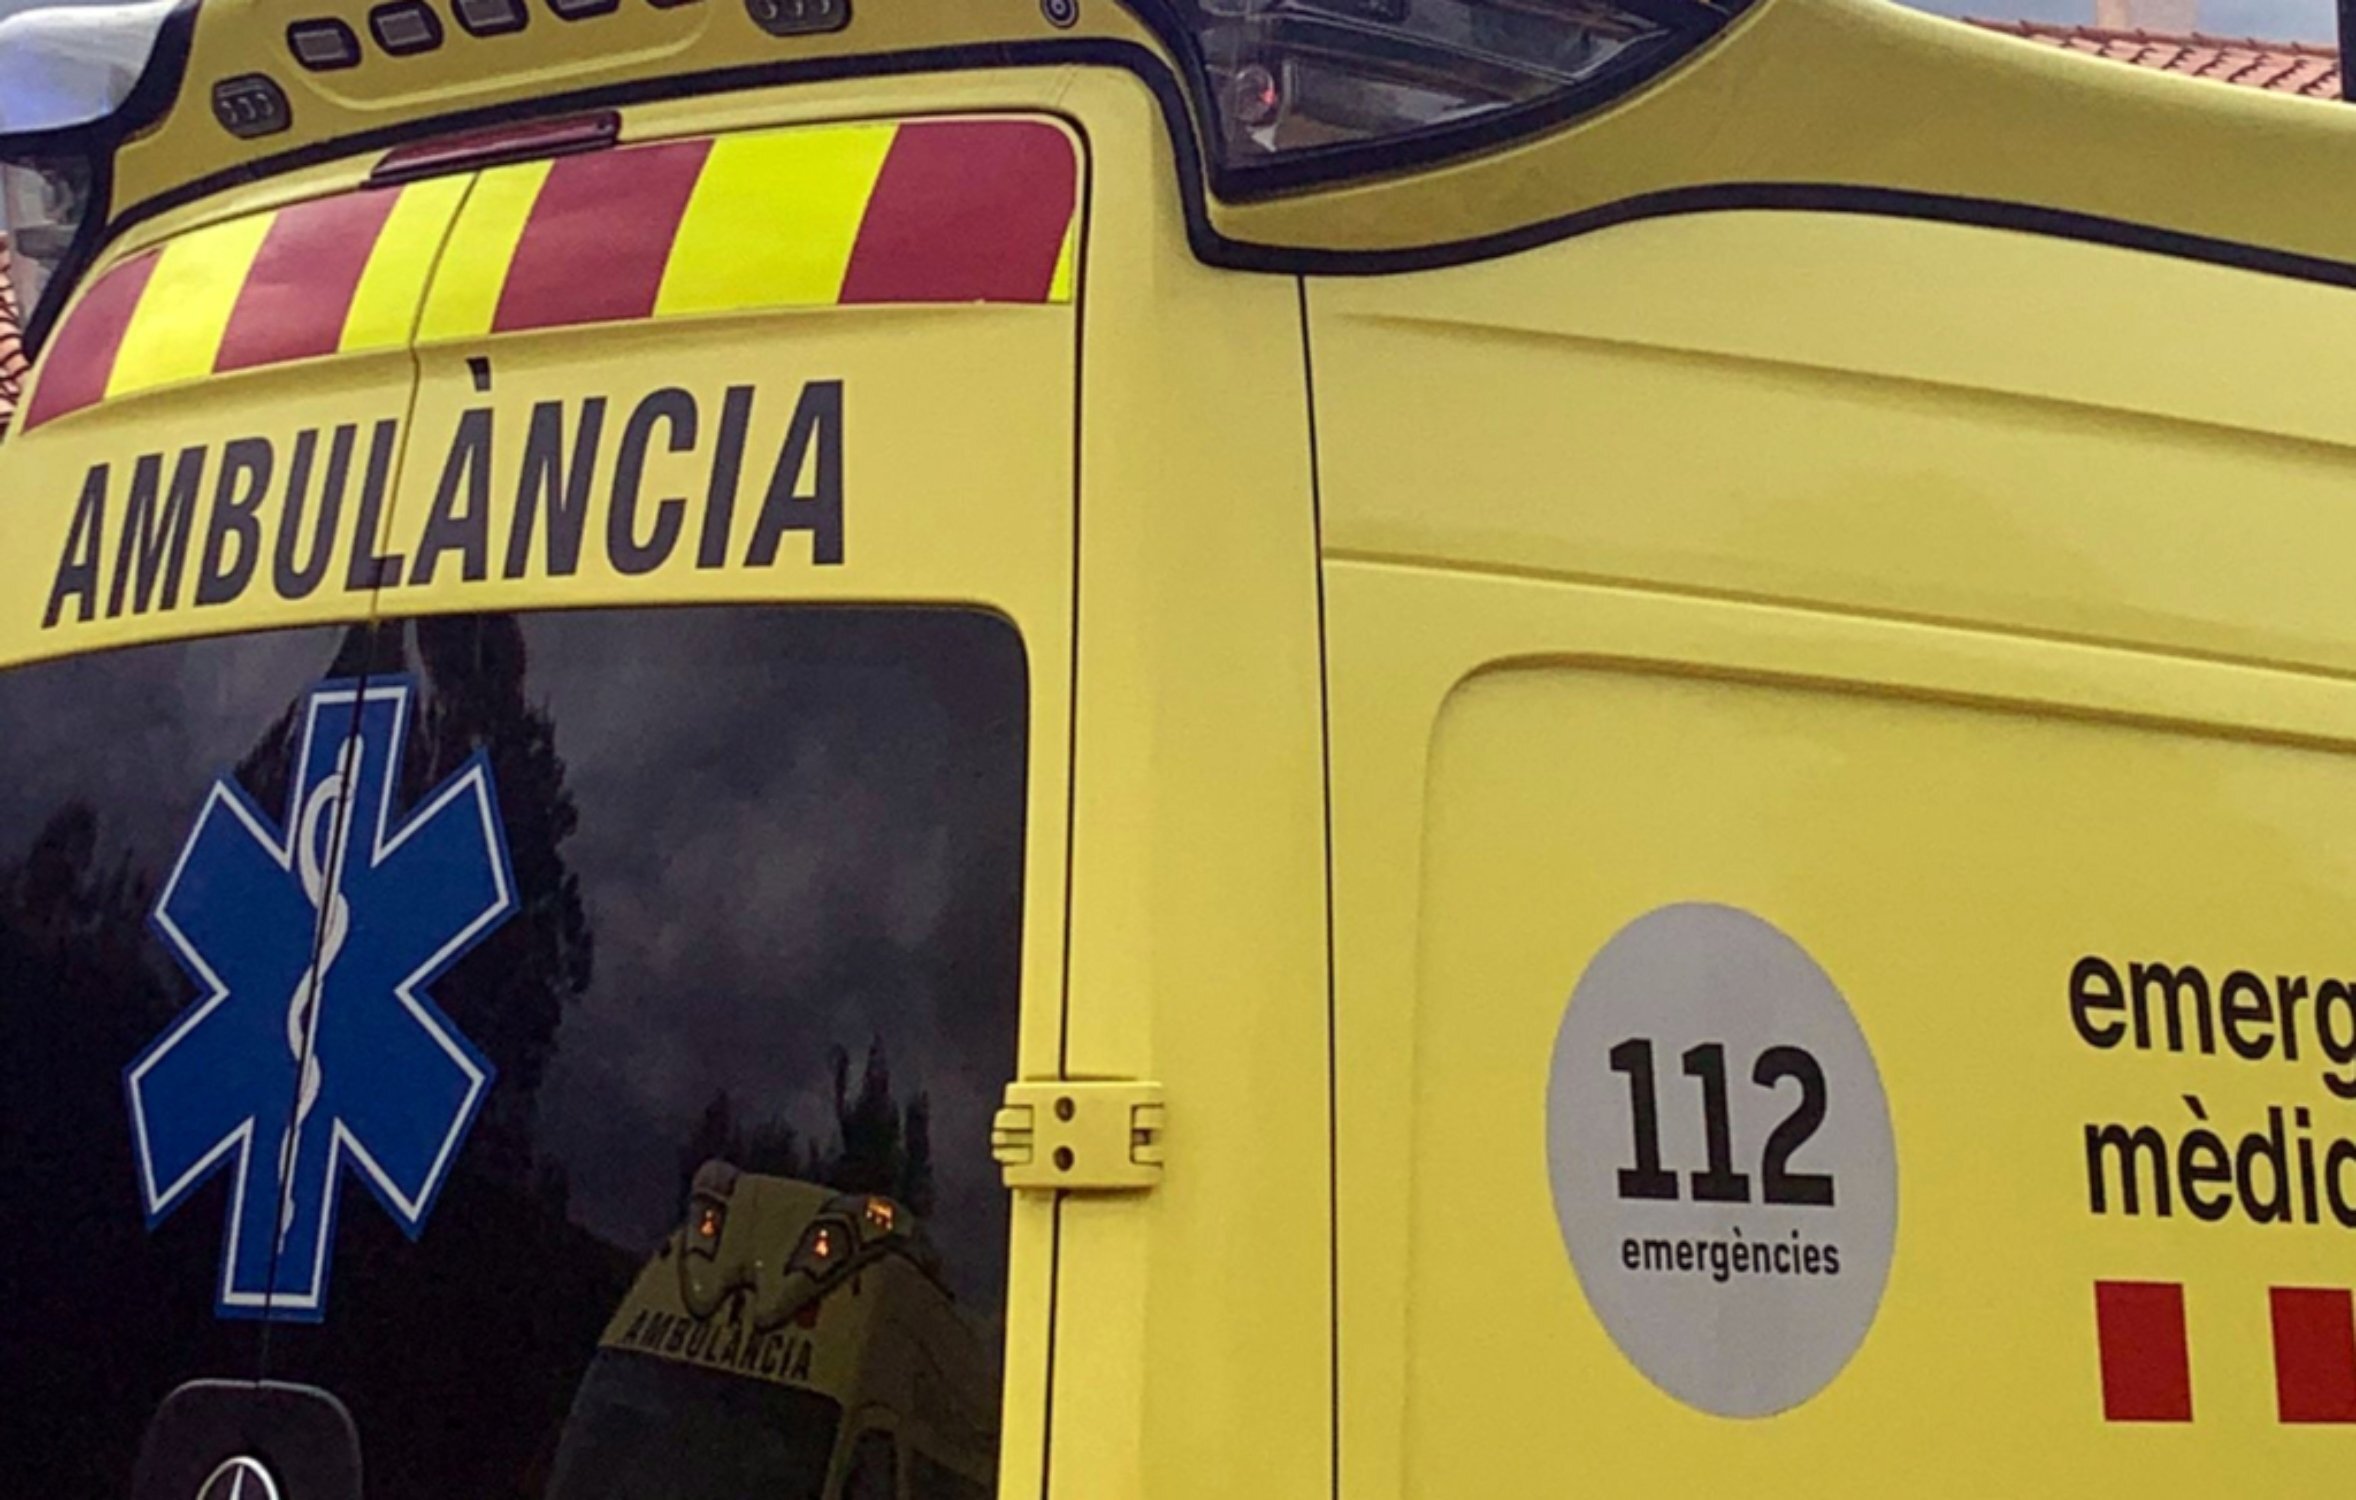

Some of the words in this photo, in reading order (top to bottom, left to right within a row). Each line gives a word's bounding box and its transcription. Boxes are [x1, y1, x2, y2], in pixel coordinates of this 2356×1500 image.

[42, 356, 844, 629] AMBULÀNCIA
[2068, 955, 2356, 1099] emerg
[1608, 1036, 1836, 1208] 112
[1621, 1225, 1841, 1284] emergències
